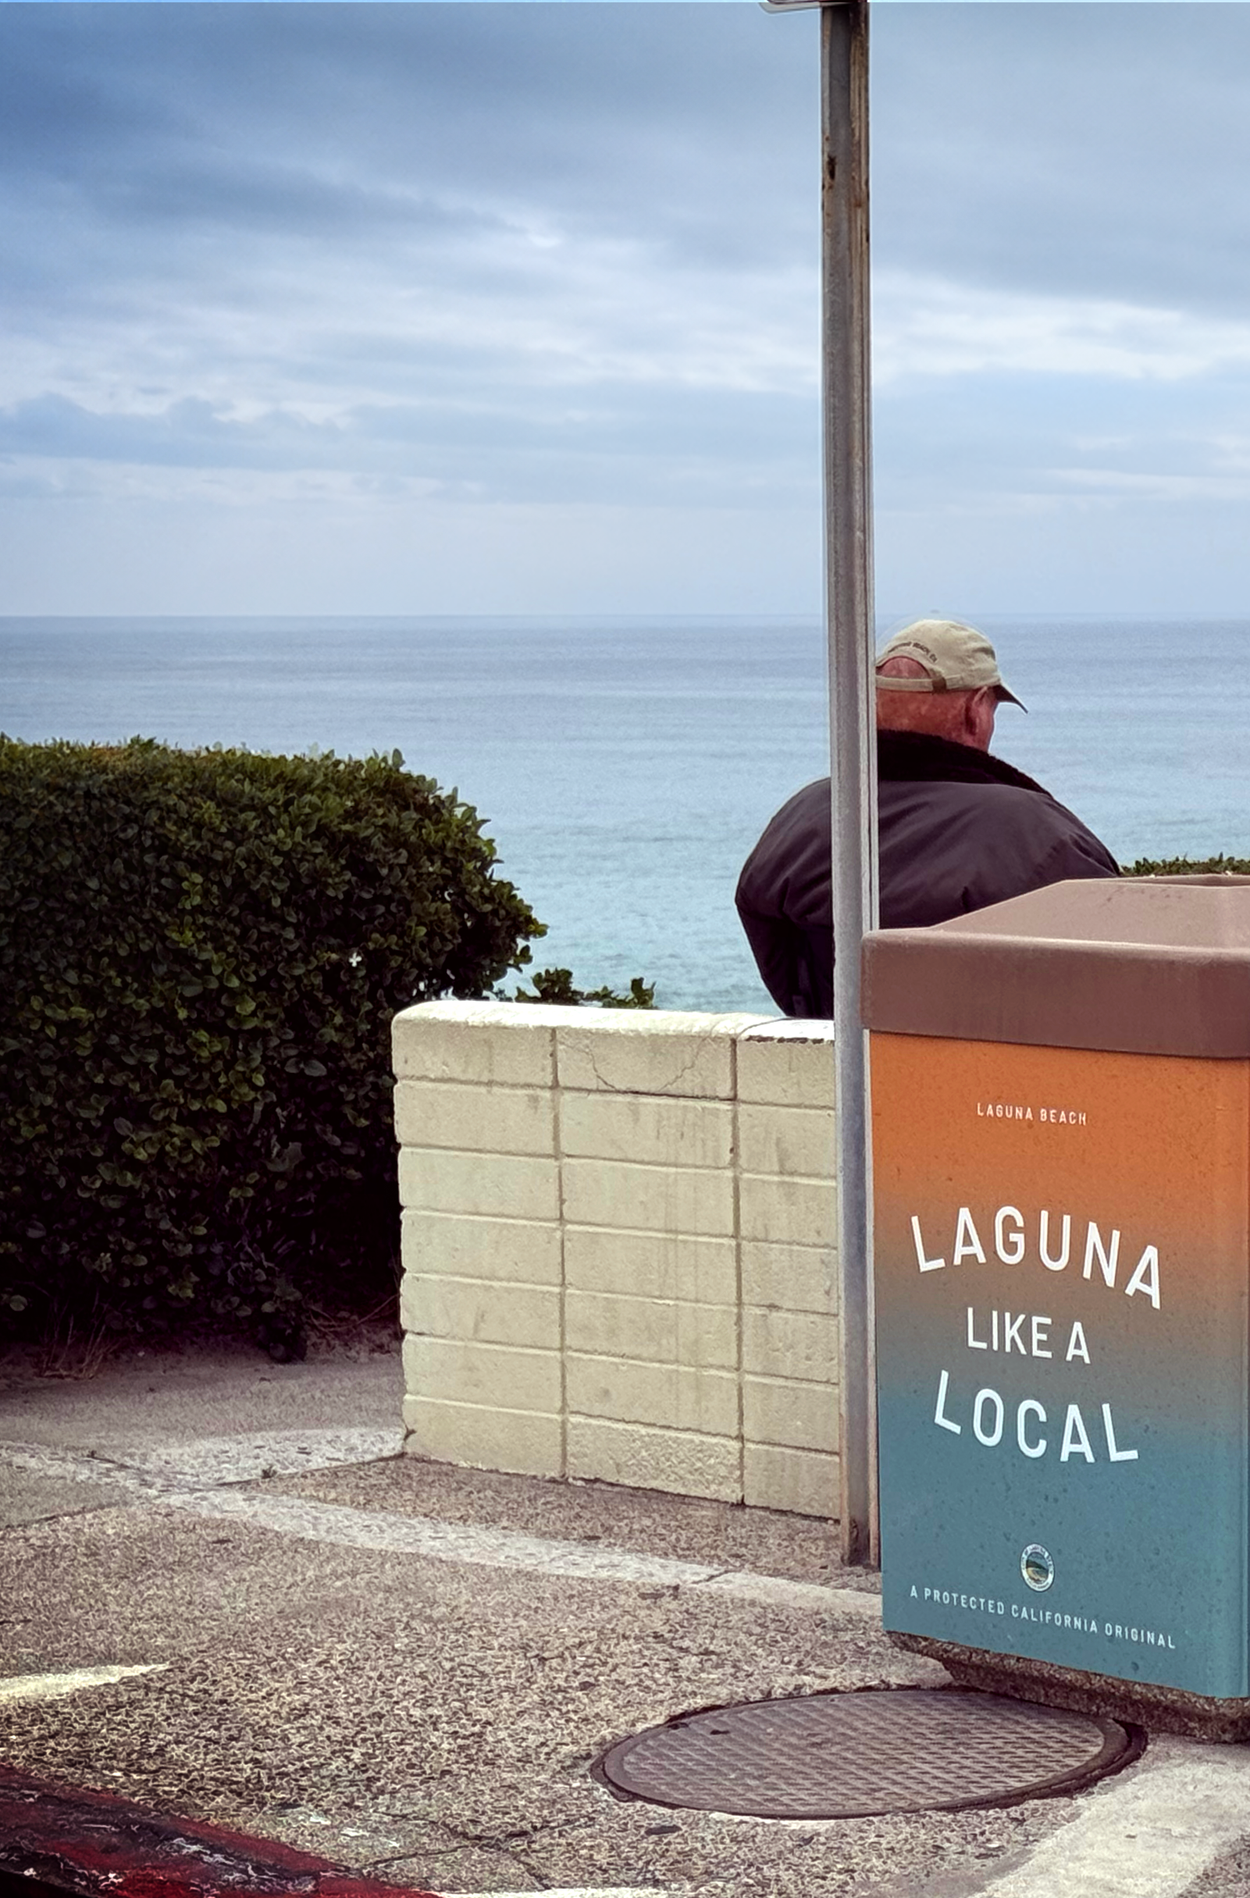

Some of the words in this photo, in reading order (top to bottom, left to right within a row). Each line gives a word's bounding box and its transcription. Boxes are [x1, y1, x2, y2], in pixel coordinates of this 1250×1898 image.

[976, 1102, 1034, 1121] LAGUNA
[1039, 1107, 1087, 1126] BEACH
[910, 1205, 1162, 1311] LAGUNA
[967, 1306, 1053, 1359] LIKE
[1065, 1320, 1091, 1365] A
[934, 1369, 1139, 1464] LOCAL
[909, 1584, 919, 1599] A
[924, 1587, 1005, 1615] PROTECTED
[1011, 1604, 1098, 1634] CALIFORNIA
[1104, 1622, 1176, 1650] ORIGINAL
